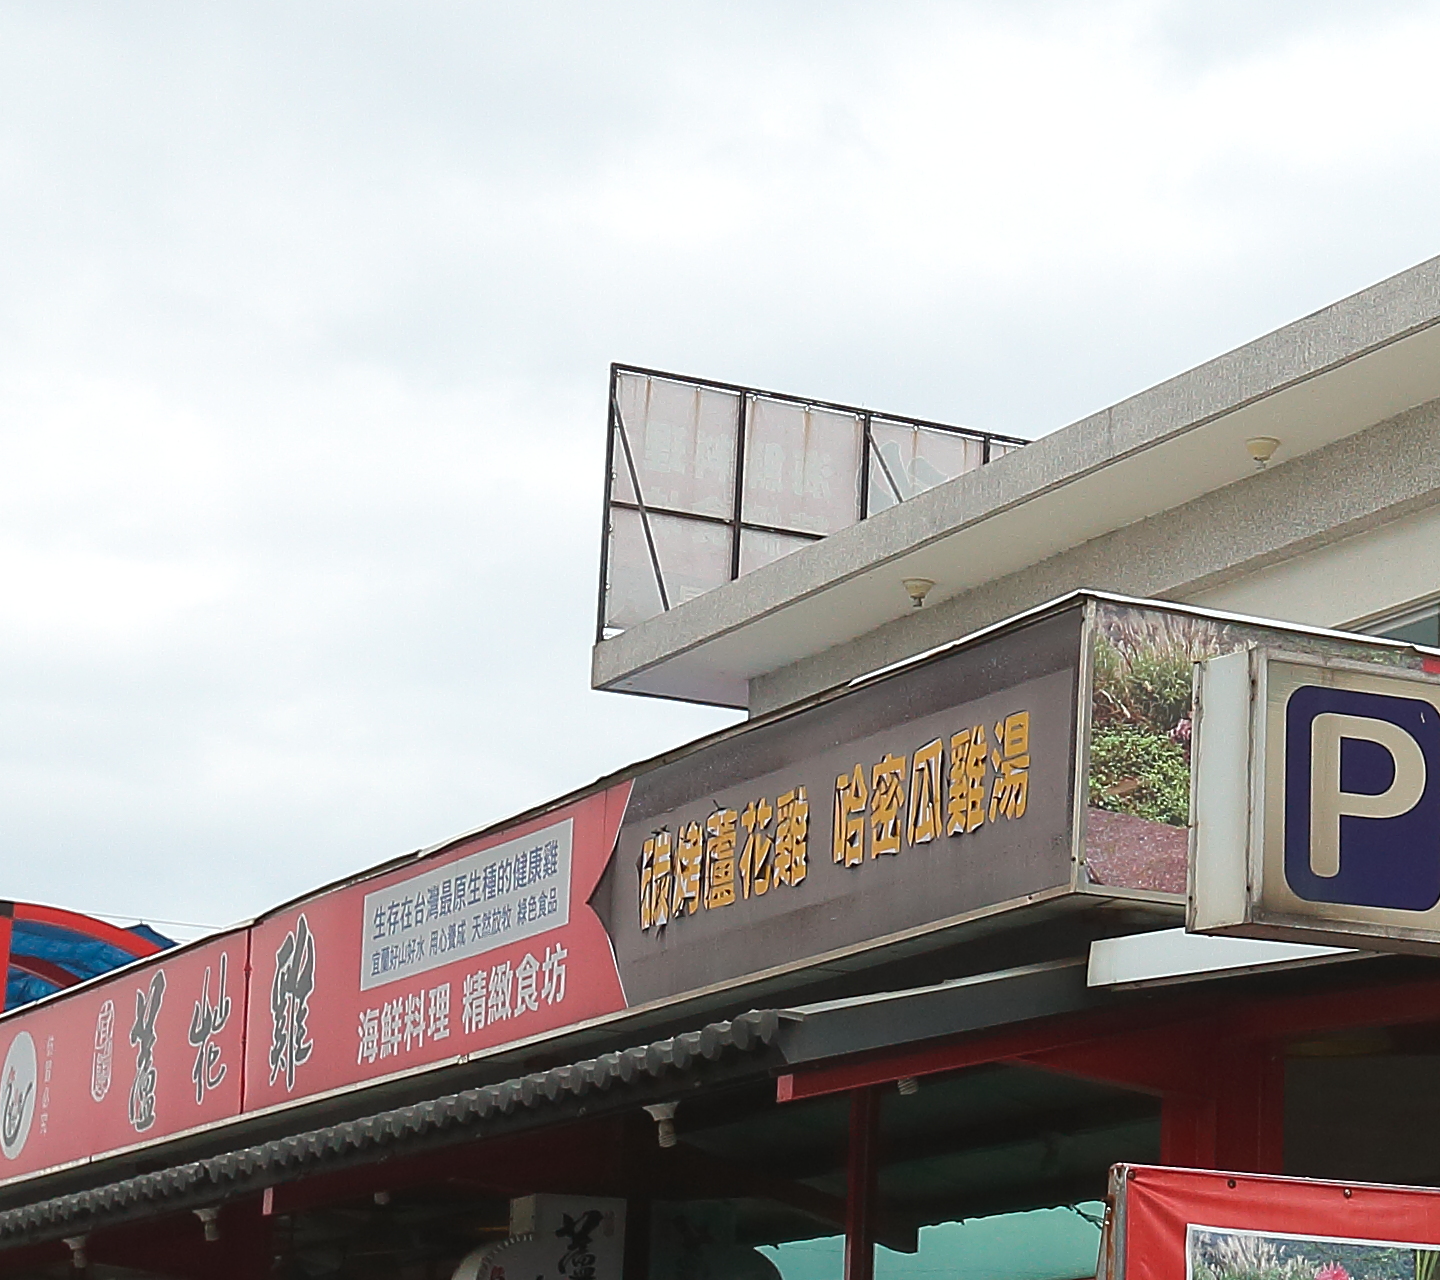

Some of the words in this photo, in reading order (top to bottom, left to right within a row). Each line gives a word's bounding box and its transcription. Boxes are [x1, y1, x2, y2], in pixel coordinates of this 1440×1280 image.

[1308, 711, 1428, 880] P
[372, 839, 559, 940] 生存在台灣最原生種的健康雞
[128, 913, 316, 1133] 蘆花雞
[357, 981, 451, 1066] 海鮮料理
[462, 941, 568, 1035] 精緻食坊
